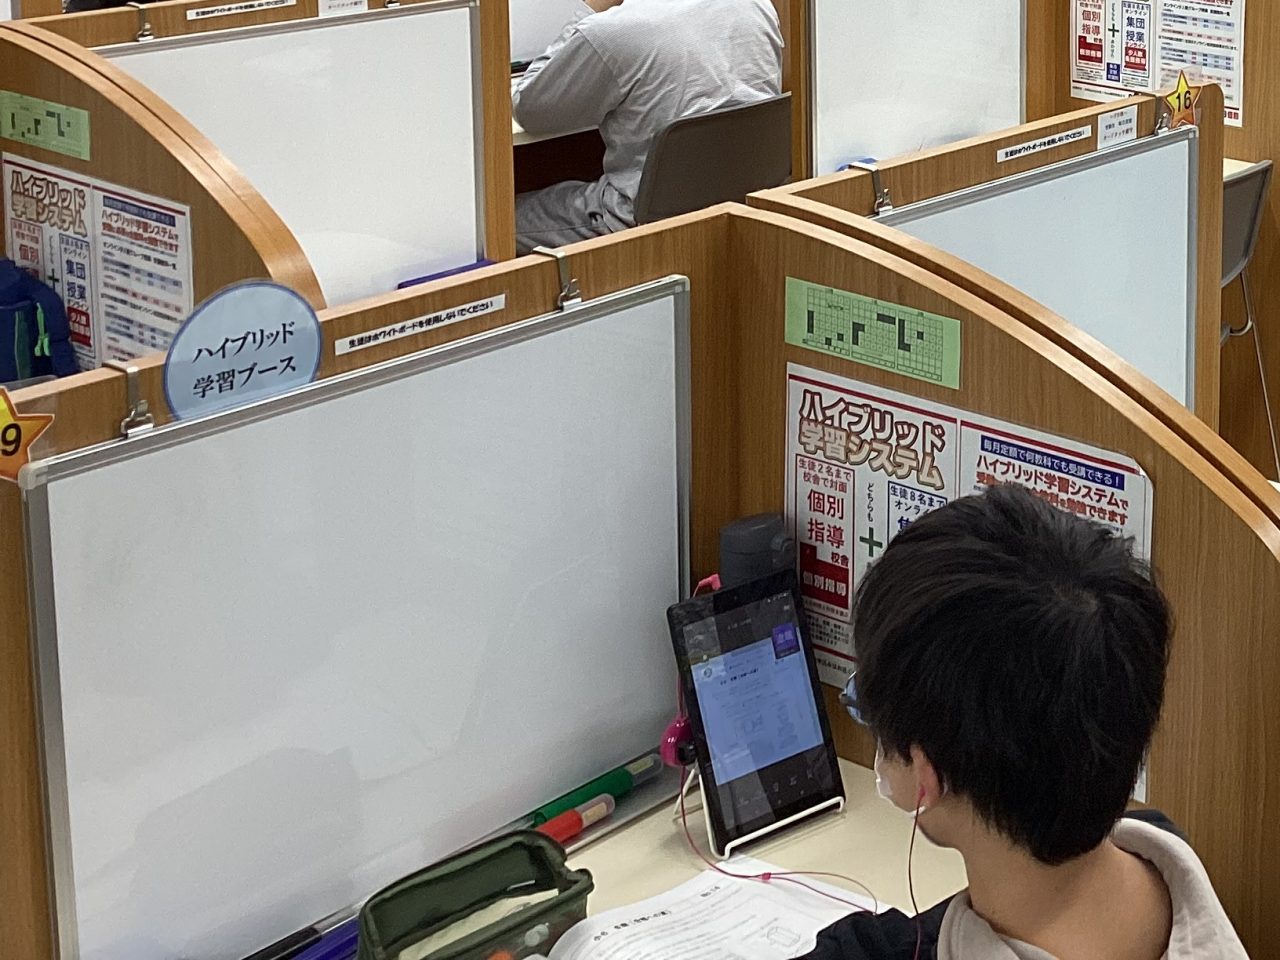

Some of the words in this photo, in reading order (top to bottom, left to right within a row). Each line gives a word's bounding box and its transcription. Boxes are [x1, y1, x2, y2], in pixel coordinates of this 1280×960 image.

[1126, 16, 1145, 29] 集団
[1175, 90, 1192, 113] 16
[10, 170, 86, 212] ハイブリッド
[193, 321, 295, 362] ハイブリッド
[193, 357, 296, 399] 学習ブース
[799, 390, 946, 453] ハイブリッド
[1, 424, 22, 456] 9
[798, 420, 946, 490] 学習システム
[806, 488, 845, 520] 個別
[806, 520, 845, 550] 指導
